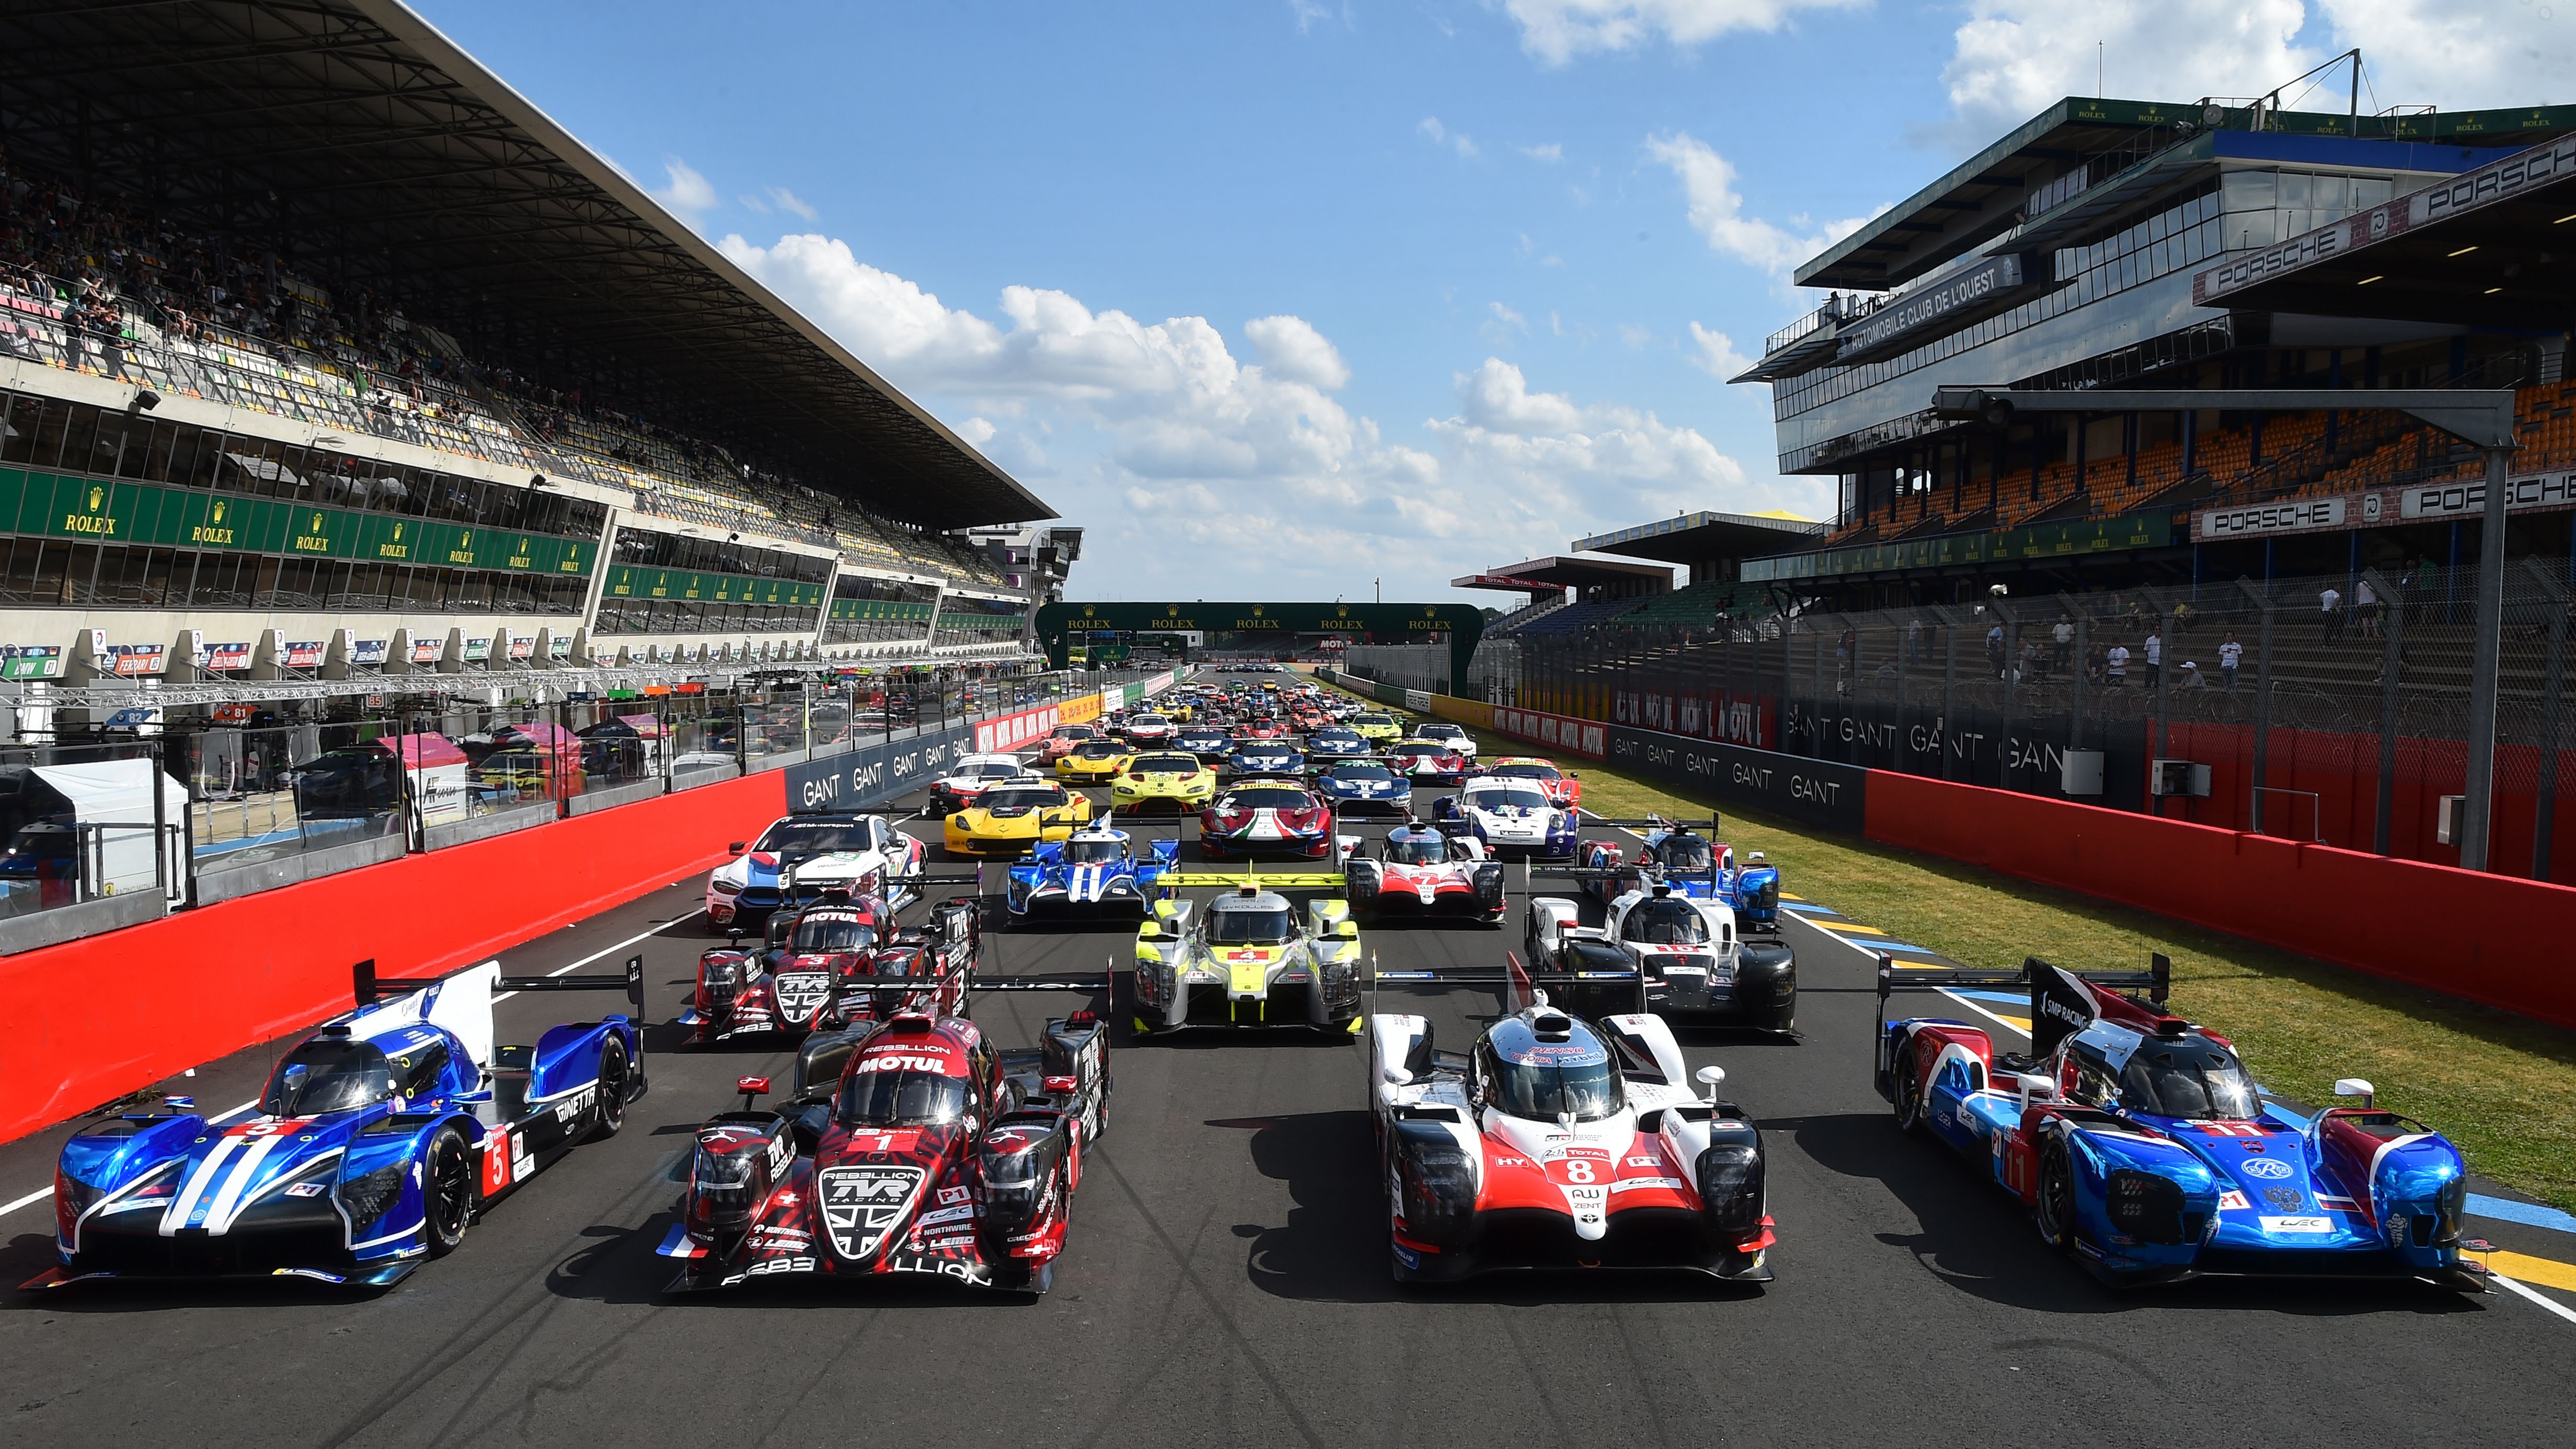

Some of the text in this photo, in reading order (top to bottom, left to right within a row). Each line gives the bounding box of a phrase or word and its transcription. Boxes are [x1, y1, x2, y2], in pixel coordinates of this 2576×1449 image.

[2078, 111, 2106, 120] ROLEX
[2218, 230, 2337, 289] PORSCHE
[1852, 269, 1995, 351] AUTOMOBILE CLUB DE L'OUEST
[2420, 477, 2576, 513] PORCH
[65, 514, 116, 534] ROLEX
[2214, 503, 2330, 533] PORSCHE
[192, 526, 233, 544] ROLEX
[2130, 534, 2149, 544] ROLEX
[296, 536, 328, 551] ROLEX
[380, 544, 407, 558] ROLEX
[2092, 539, 2109, 548] ROLEX
[450, 551, 474, 564] ROLEX
[509, 556, 531, 568] ROLEX
[561, 560, 579, 572] ROLEX
[1237, 620, 1279, 629] ROLEX
[1321, 620, 1363, 629] ROLEX
[1408, 620, 1451, 629] ROLEX
[369, 696, 382, 705] 85
[129, 713, 142, 722] 82
[235, 708, 247, 717] 81
[978, 724, 994, 753] MOTUL
[1541, 718, 1557, 743] MOTUL
[1560, 721, 1579, 749] MOTUL
[1840, 717, 1896, 749] GANT
[1582, 724, 1603, 755] MOTUL
[1616, 739, 1638, 756] GANT
[926, 744, 946, 766] GANT
[953, 738, 970, 758] GANT
[1647, 745, 1674, 767] GANT
[893, 752, 917, 777] GANT
[1686, 753, 1718, 776] GANT
[854, 762, 882, 791] GANT
[1733, 763, 1772, 790] GANT
[803, 774, 840, 807] GANT
[1791, 775, 1839, 806] GANT
[1420, 877, 1430, 885] 7
[801, 912, 859, 924] MOTUL
[808, 956, 825, 965] 3
[2047, 998, 2087, 1028] SMP RACING
[863, 1043, 951, 1055] REBELLION
[856, 1055, 946, 1074] MOTUL
[1509, 1052, 1552, 1064] TOYOTA
[555, 1086, 596, 1123] GINETTA
[254, 1122, 279, 1136] 5
[492, 1126, 507, 1141] TOTAL
[2207, 1124, 2264, 1136] 11
[873, 1135, 893, 1150] 1
[1993, 1132, 2000, 1152] P1
[2011, 1131, 2029, 1147] TOTAL
[514, 1138, 523, 1158] P1
[492, 1144, 503, 1186] 5
[1634, 1157, 1656, 1166] P1
[1567, 1160, 1586, 1183] 8
[2005, 1151, 2026, 1193] 11
[291, 1184, 316, 1195] P1
[831, 1180, 911, 1198] TVR
[942, 1188, 966, 1203] P1
[929, 1205, 969, 1219] WEC
[924, 1223, 973, 1236] NORTHWIRE
[2279, 1218, 2321, 1227] WEC
[929, 1235, 975, 1248] LEMO
